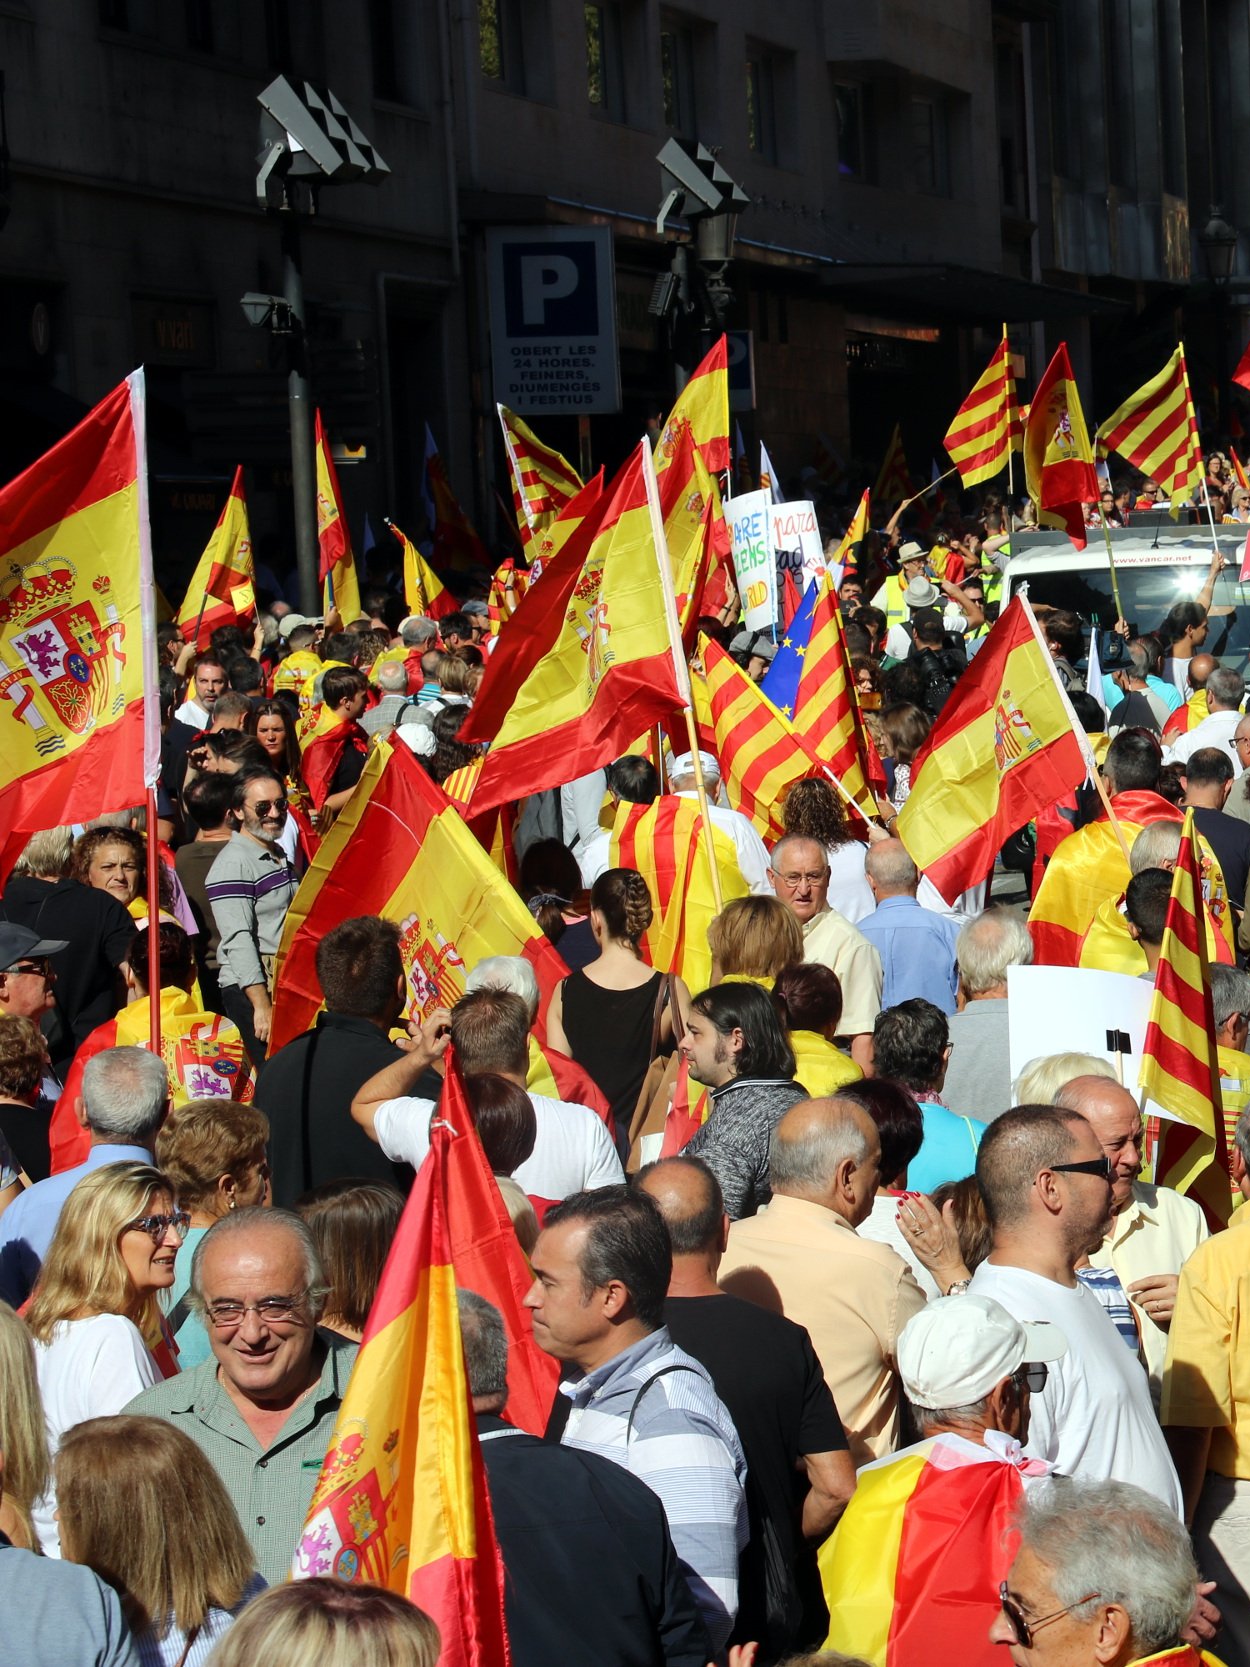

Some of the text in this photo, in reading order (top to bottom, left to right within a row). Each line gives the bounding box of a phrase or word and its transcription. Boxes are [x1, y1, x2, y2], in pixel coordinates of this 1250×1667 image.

[521, 255, 579, 325] P
[511, 345, 597, 356] OBERT LES
[513, 358, 595, 369] 24 HORES.
[520, 370, 589, 381] FEINERS,
[509, 382, 600, 393] DIUMENGES
[530, 395, 593, 405] FESTIUS
[773, 511, 817, 549] para
[1112, 555, 1193, 565] www.vancar.net
